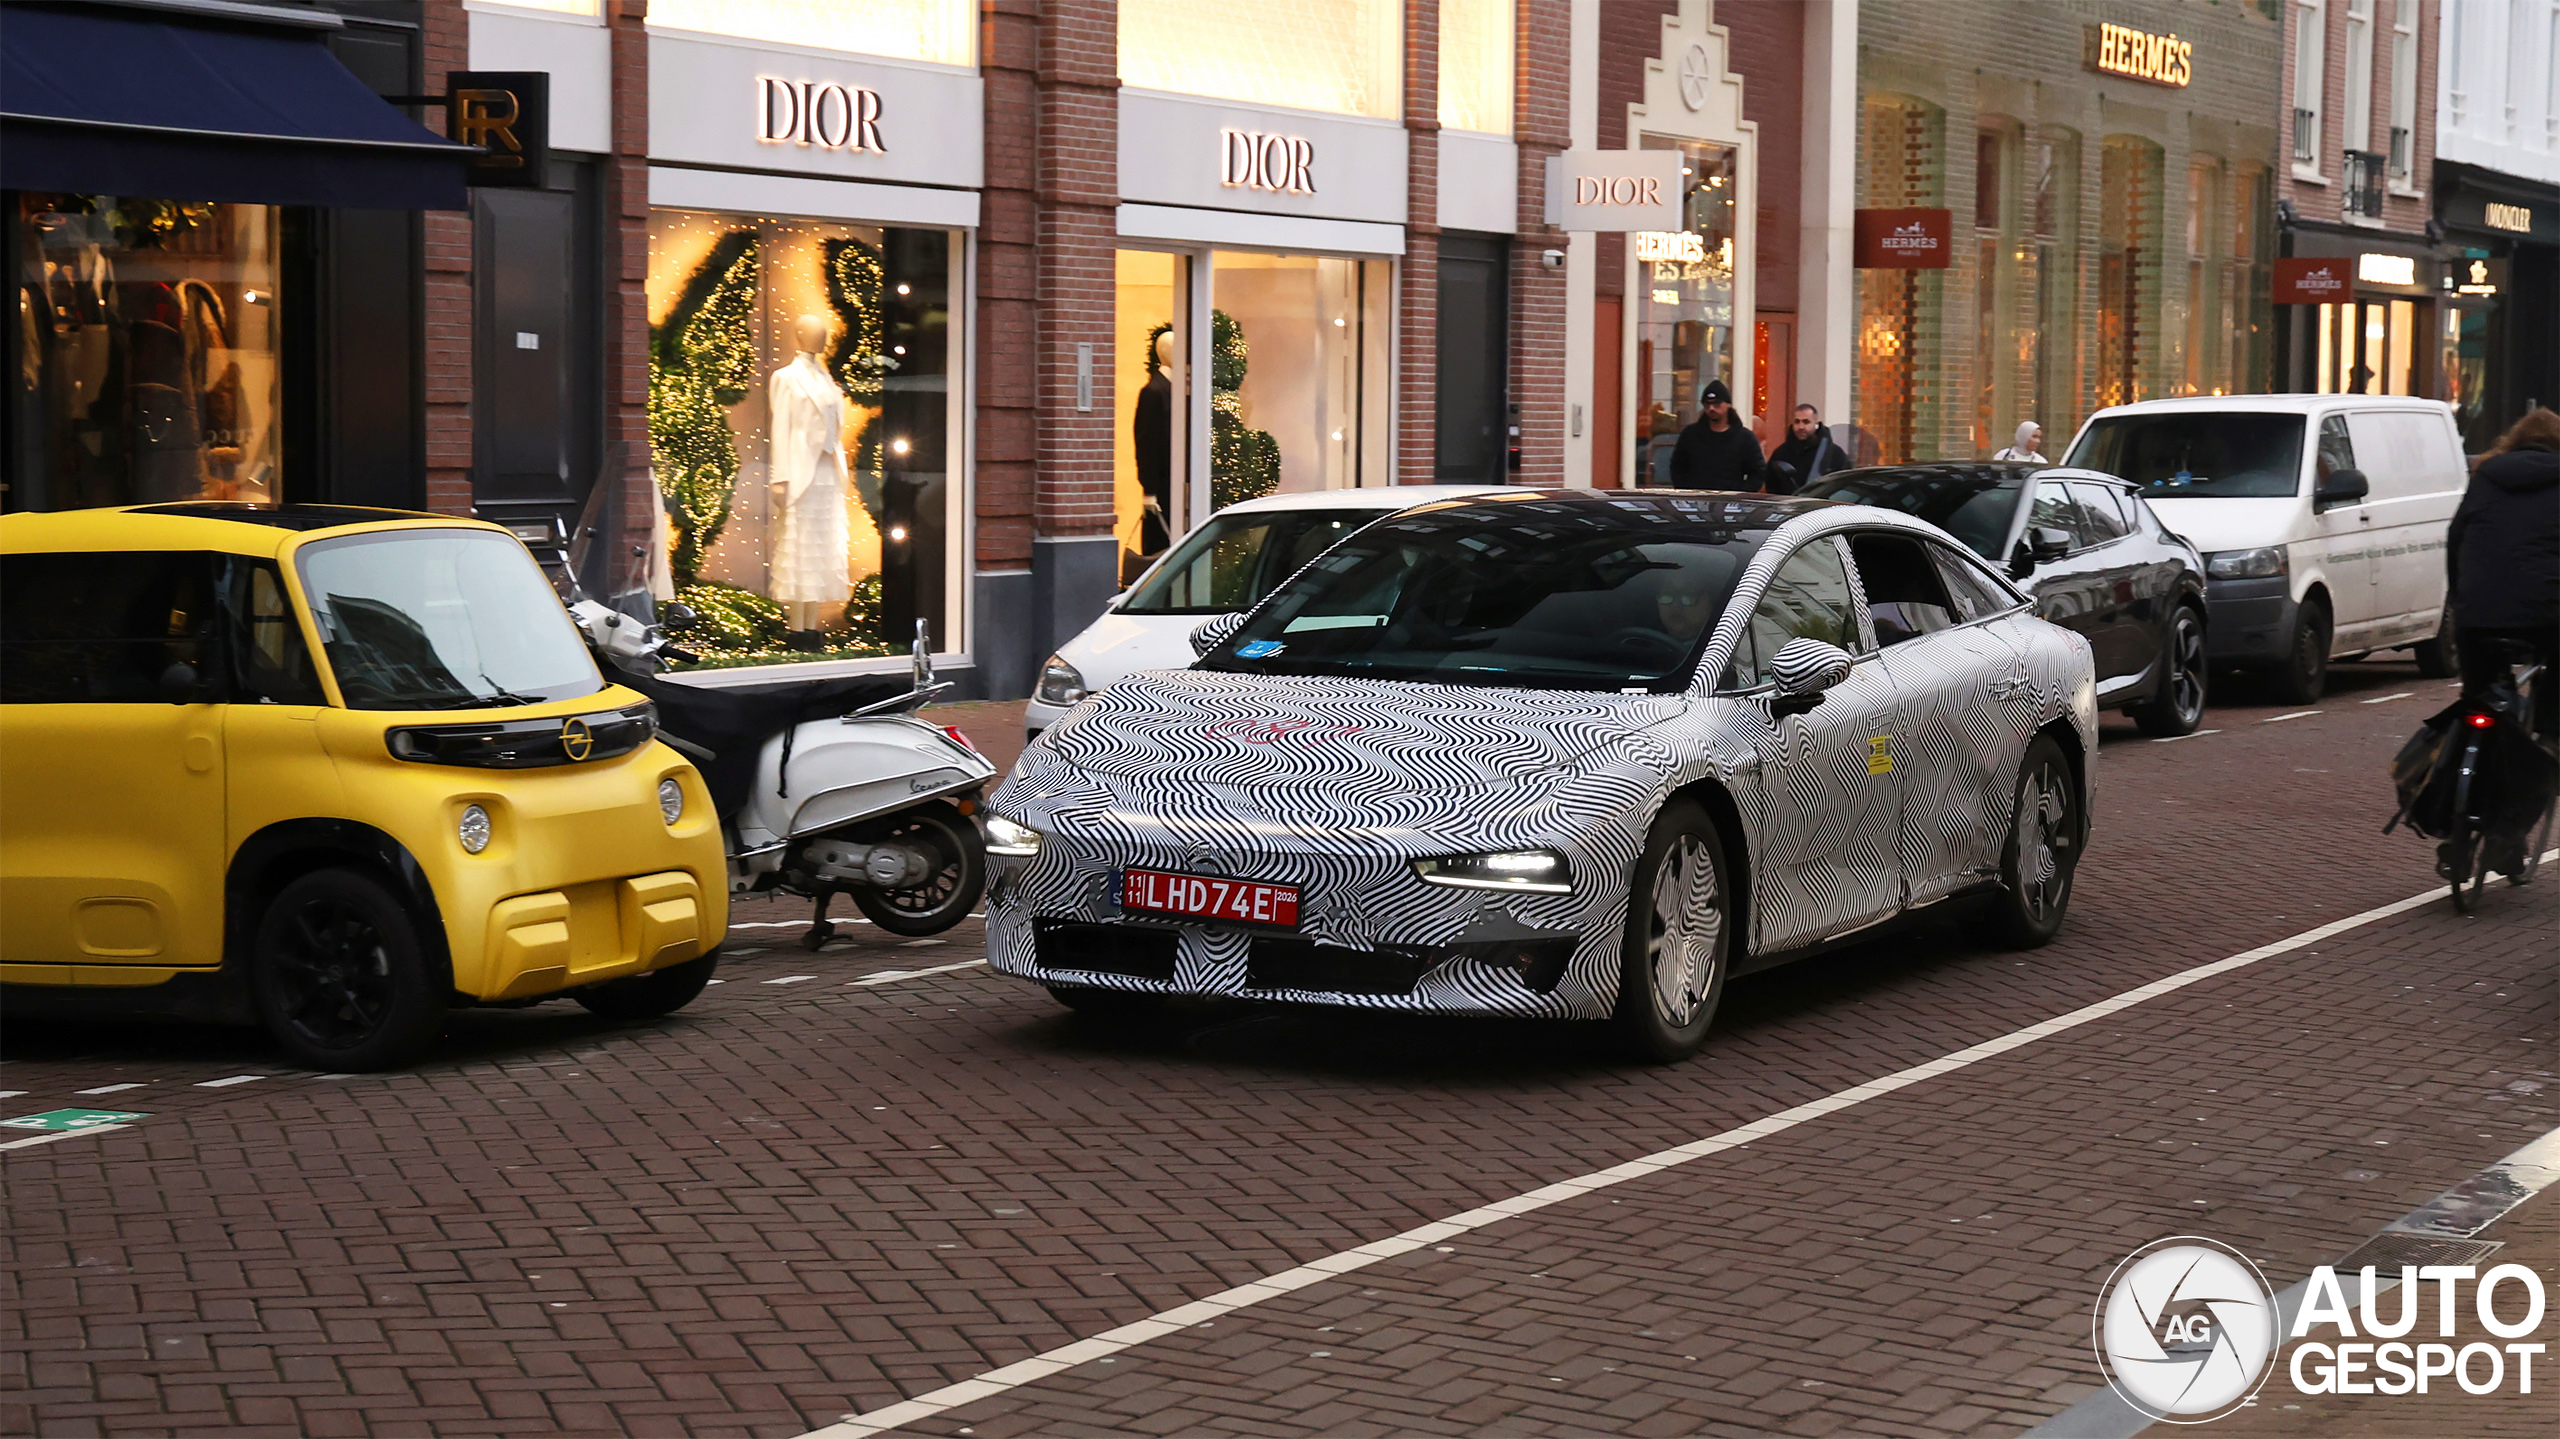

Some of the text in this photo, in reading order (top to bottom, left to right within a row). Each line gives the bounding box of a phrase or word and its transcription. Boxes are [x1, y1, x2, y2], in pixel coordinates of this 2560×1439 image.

[756, 76, 888, 154] DIOR
[1220, 129, 1317, 195] DIOR
[1575, 176, 1662, 206] DIOR
[1128, 874, 1143, 888] 11
[1127, 890, 1142, 904] 11
[1147, 875, 1272, 921] LHD74E
[1276, 890, 1298, 904] 2026
